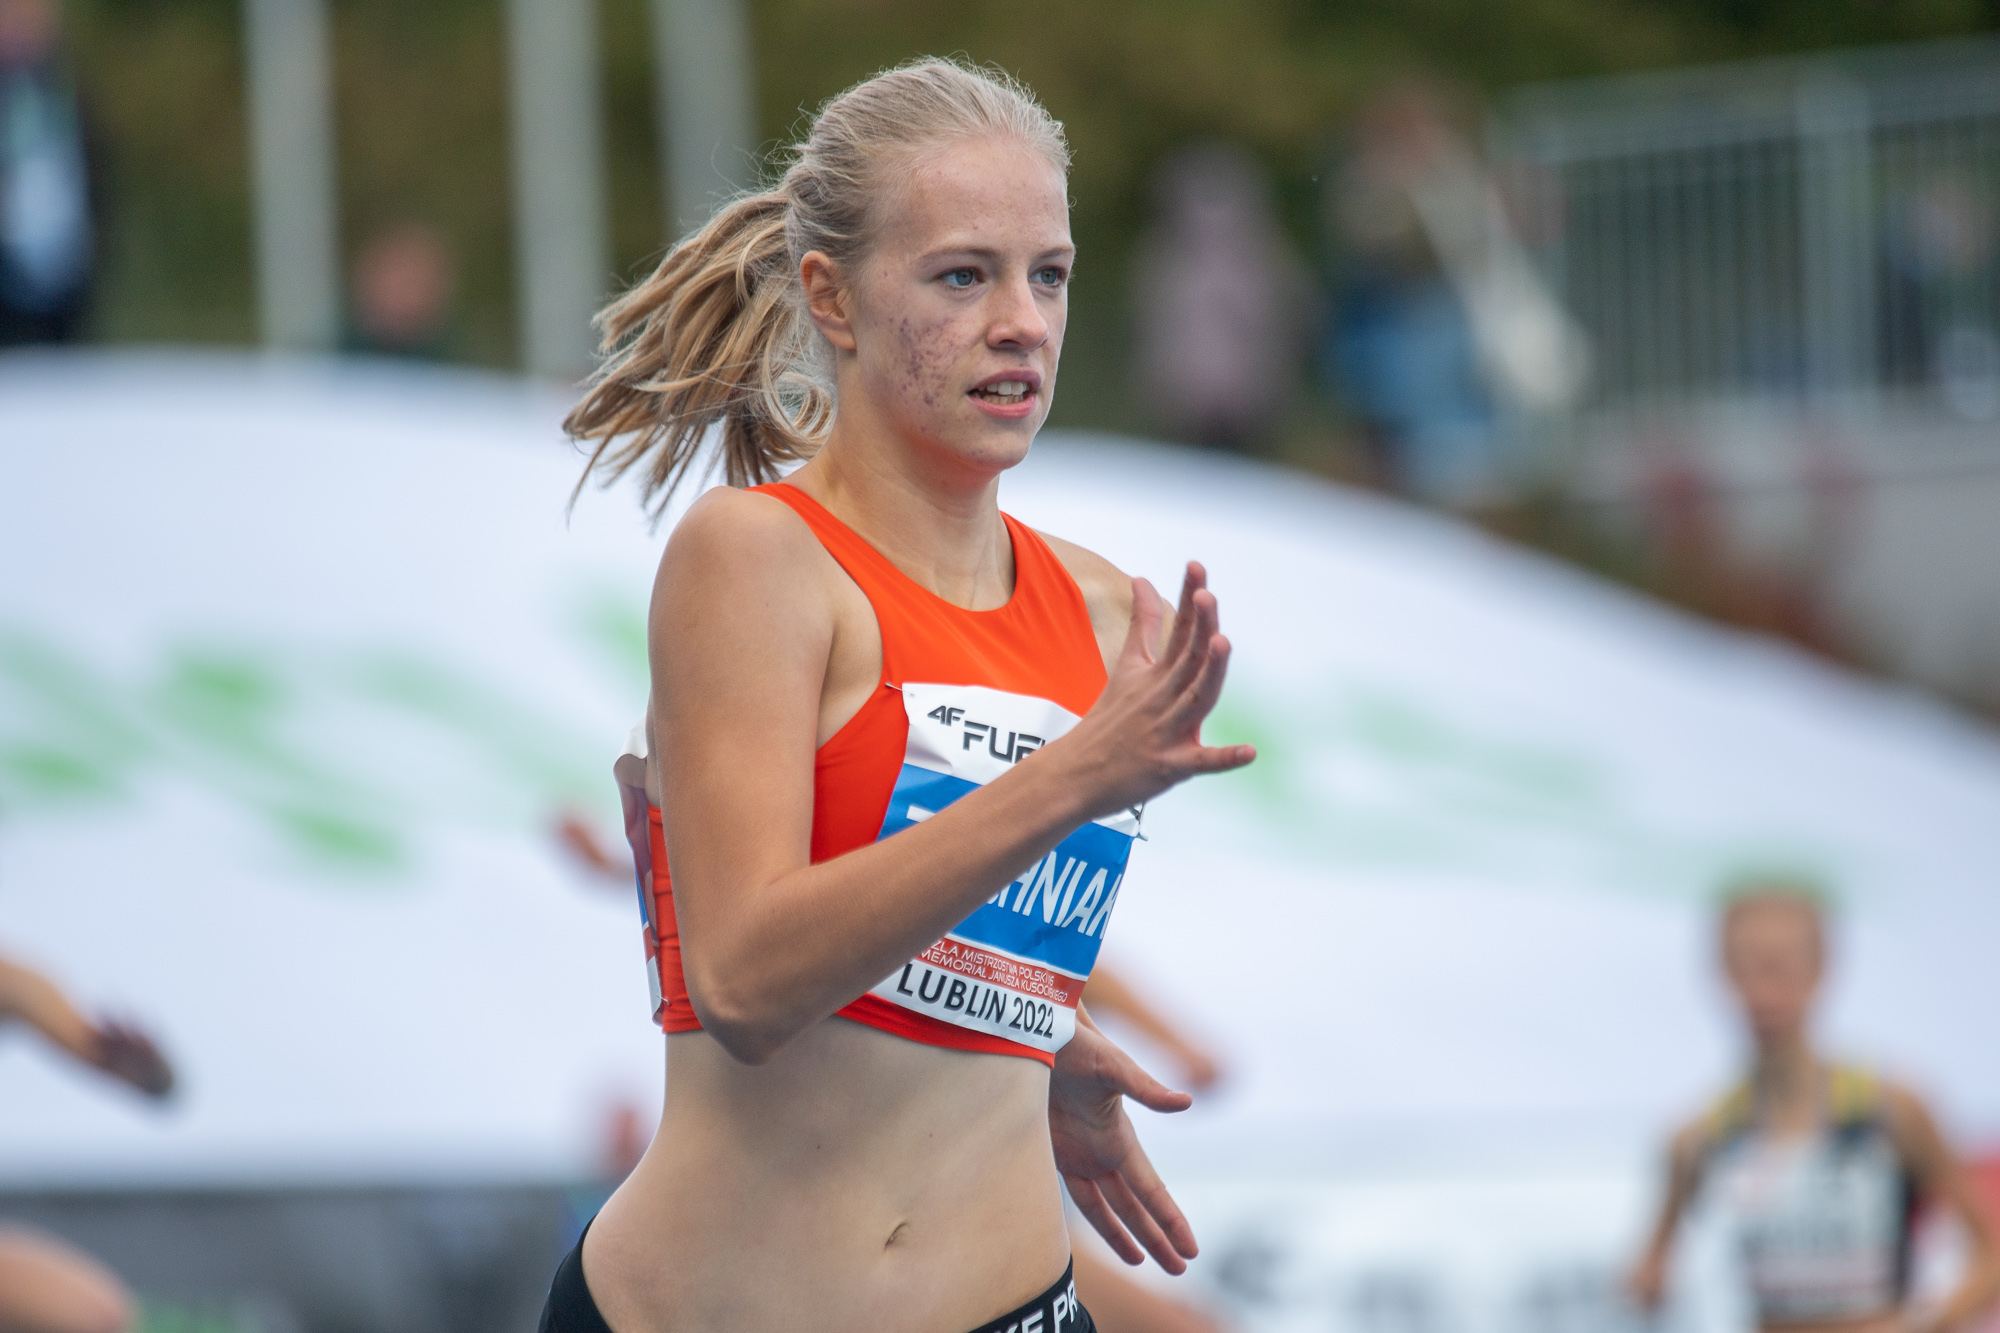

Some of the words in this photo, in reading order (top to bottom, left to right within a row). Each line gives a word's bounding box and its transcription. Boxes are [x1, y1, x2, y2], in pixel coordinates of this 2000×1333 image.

[927, 705, 965, 727] 4F
[962, 720, 1046, 764] FUE
[961, 949, 1018, 976] MISTRZOSTWA
[988, 970, 1020, 989] JANUSZA
[896, 963, 1008, 1024] LUBLIN
[1008, 996, 1054, 1039] 2022
